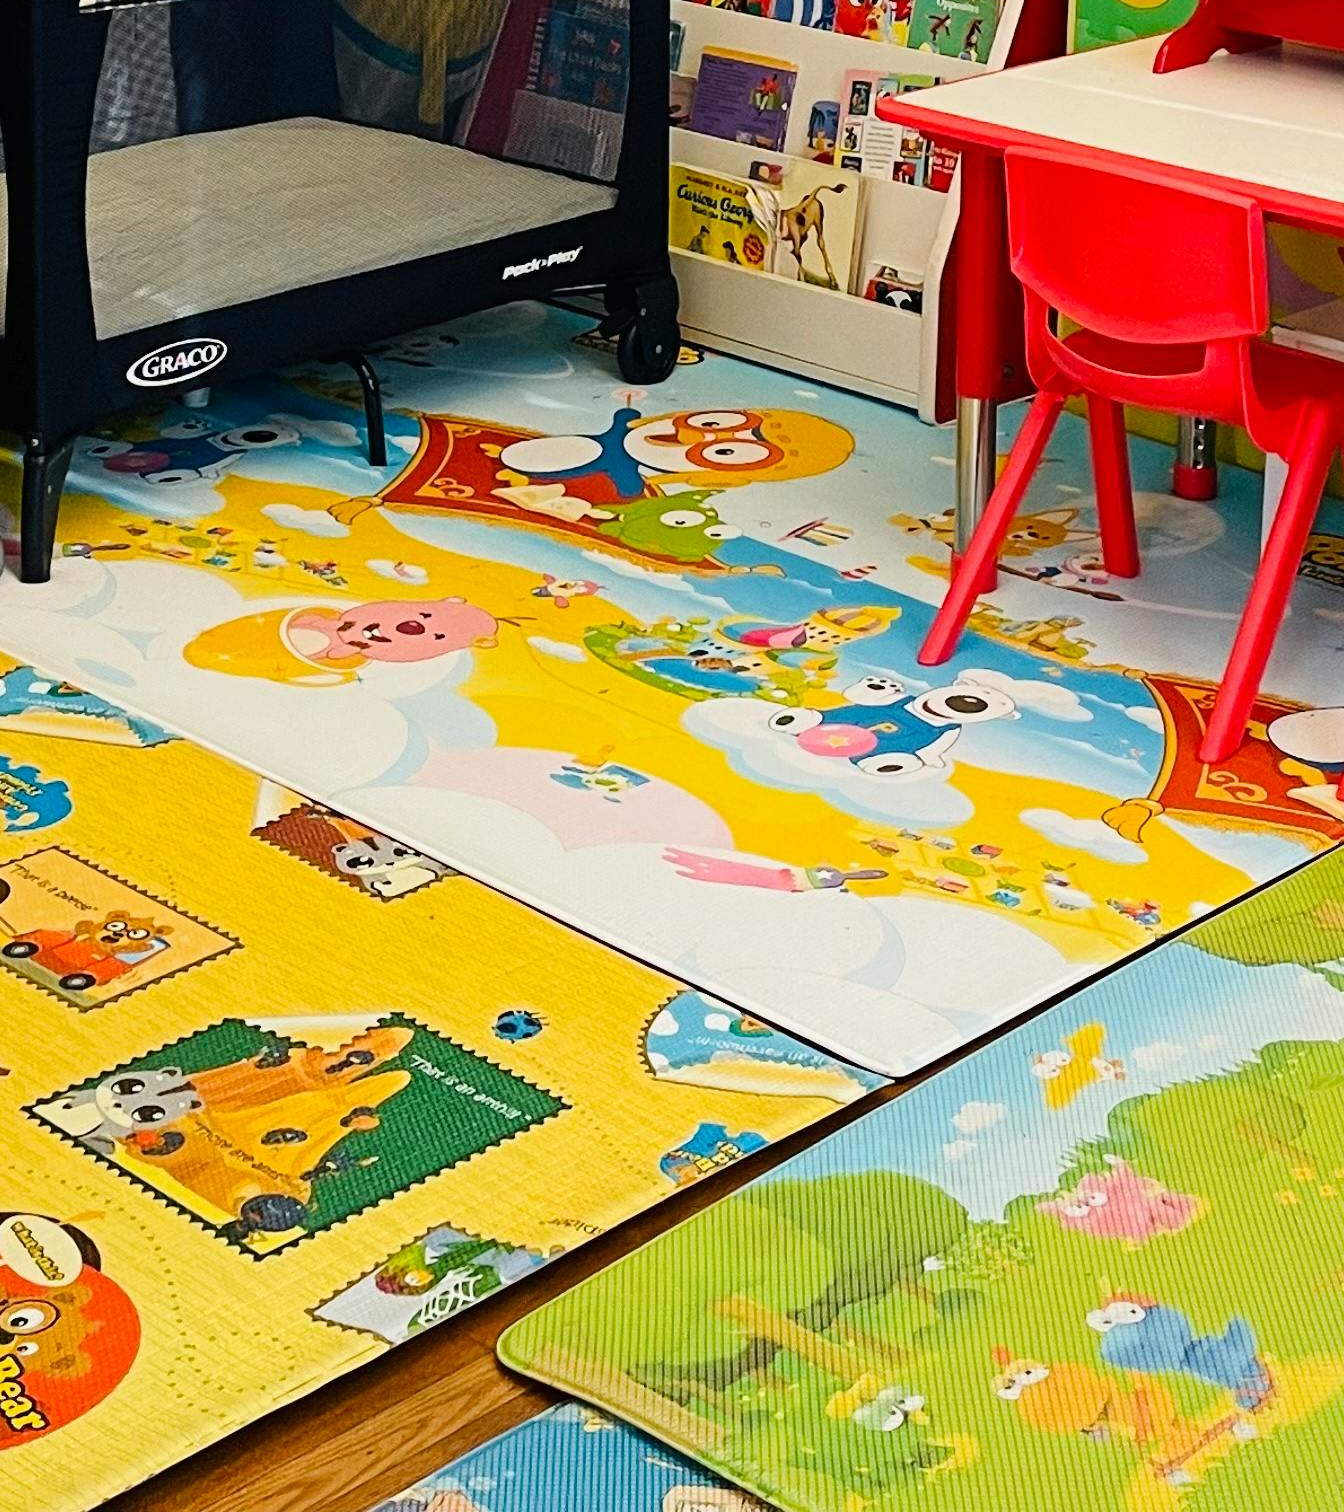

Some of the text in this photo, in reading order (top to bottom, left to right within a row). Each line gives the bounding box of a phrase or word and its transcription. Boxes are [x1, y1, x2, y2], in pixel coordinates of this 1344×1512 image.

[677, 184, 754, 225] Curious Georg
[142, 344, 219, 378] GRACO
